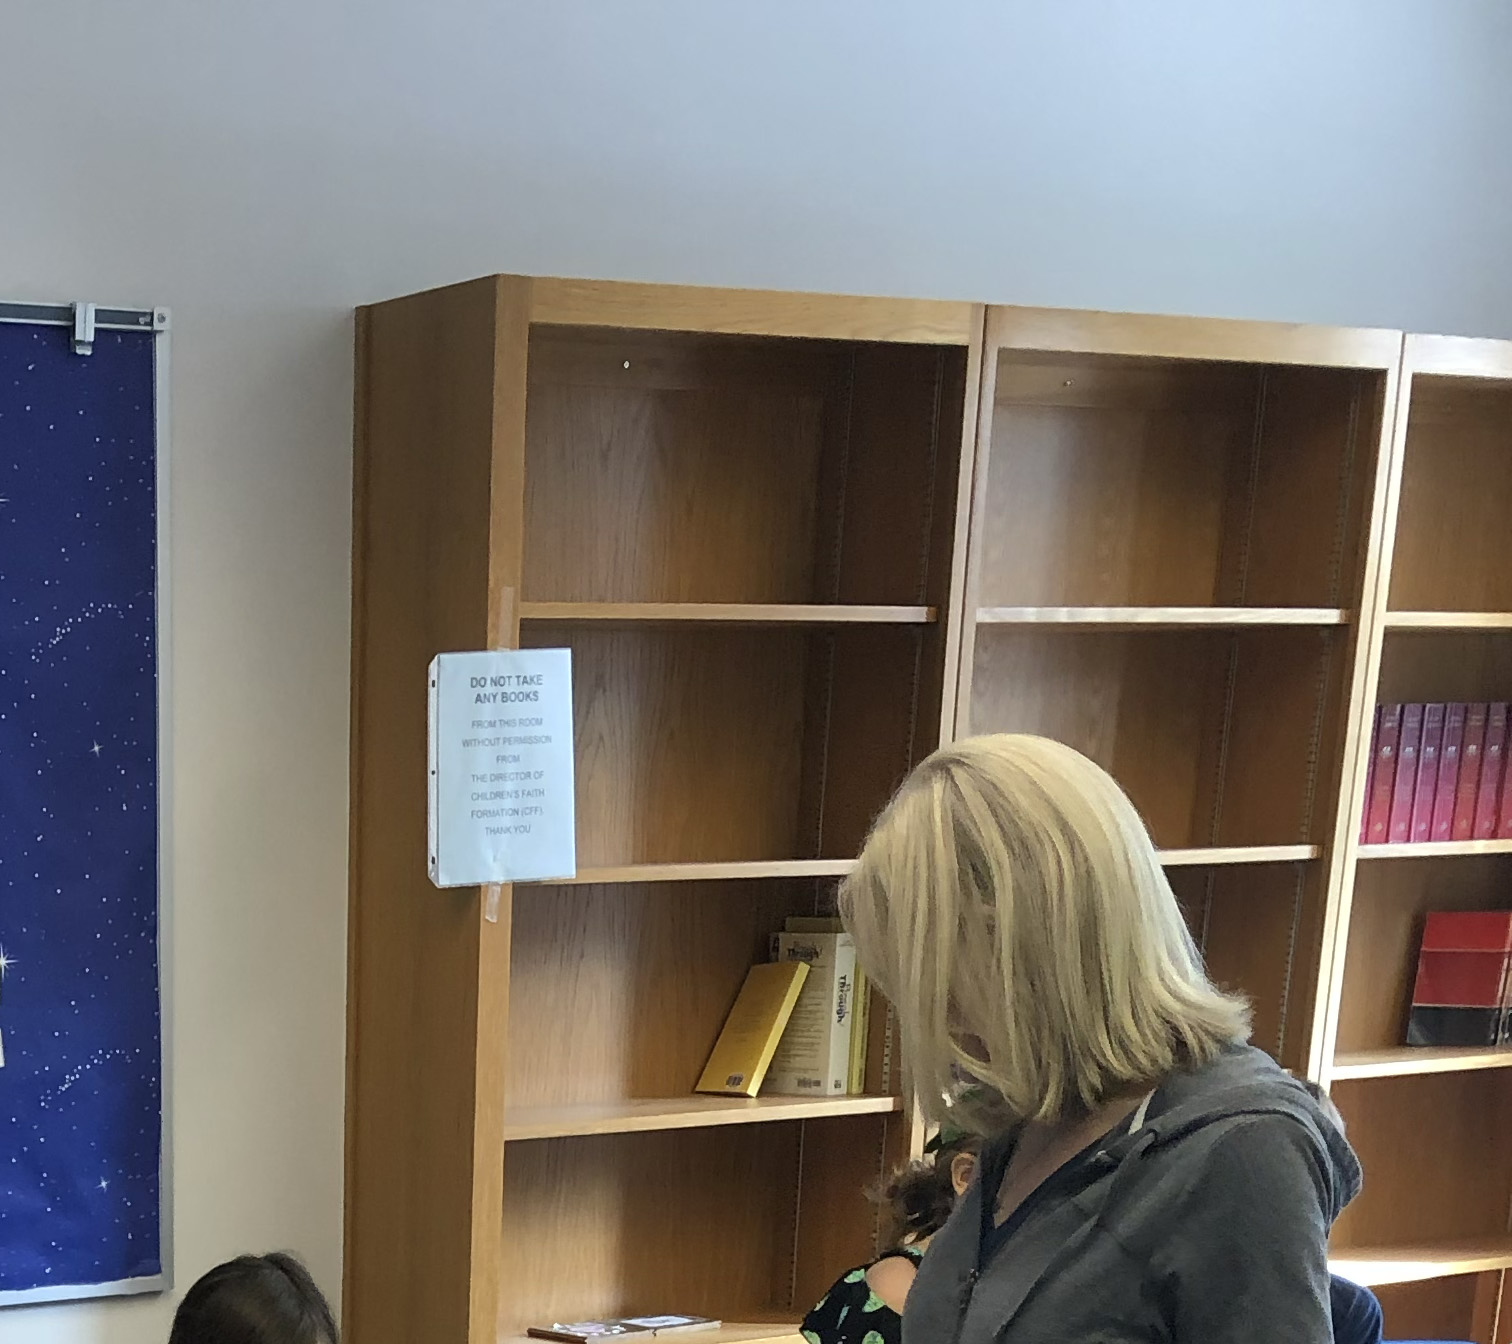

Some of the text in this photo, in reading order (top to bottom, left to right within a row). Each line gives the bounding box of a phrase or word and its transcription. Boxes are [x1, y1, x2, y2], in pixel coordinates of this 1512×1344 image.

[470, 674, 543, 688] DO NOT TAKE
[474, 691, 539, 704] ANY BOOKS
[471, 718, 543, 729] FROM THIS ROOM
[462, 735, 552, 748] WITHOUT PERMISSION
[496, 754, 520, 764] FROM
[471, 774, 488, 783] THE
[489, 772, 531, 782] DIRECTOR
[485, 824, 531, 836] THANK YOU
